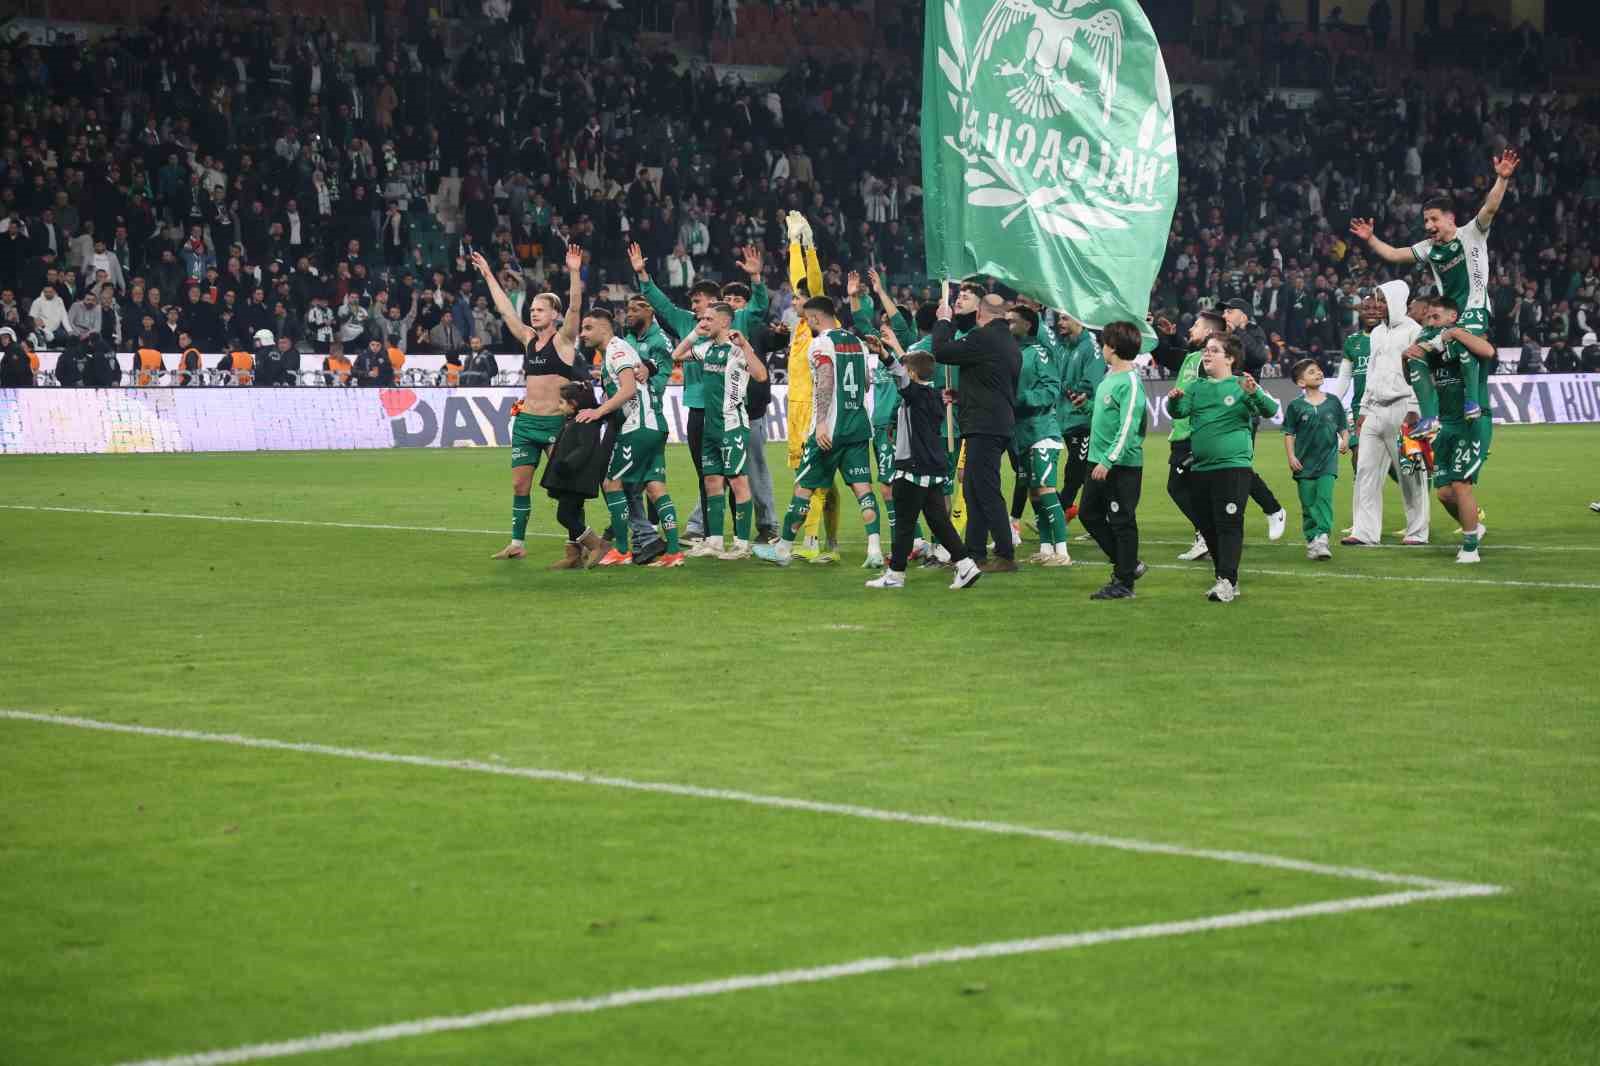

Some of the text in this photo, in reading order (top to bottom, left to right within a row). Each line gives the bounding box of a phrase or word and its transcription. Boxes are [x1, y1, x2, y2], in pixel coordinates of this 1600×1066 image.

[843, 361, 859, 399] 4
[1487, 382, 1557, 423] AYI
[389, 396, 519, 448] DAY
[878, 452, 893, 468] 21
[1455, 448, 1471, 464] 24
